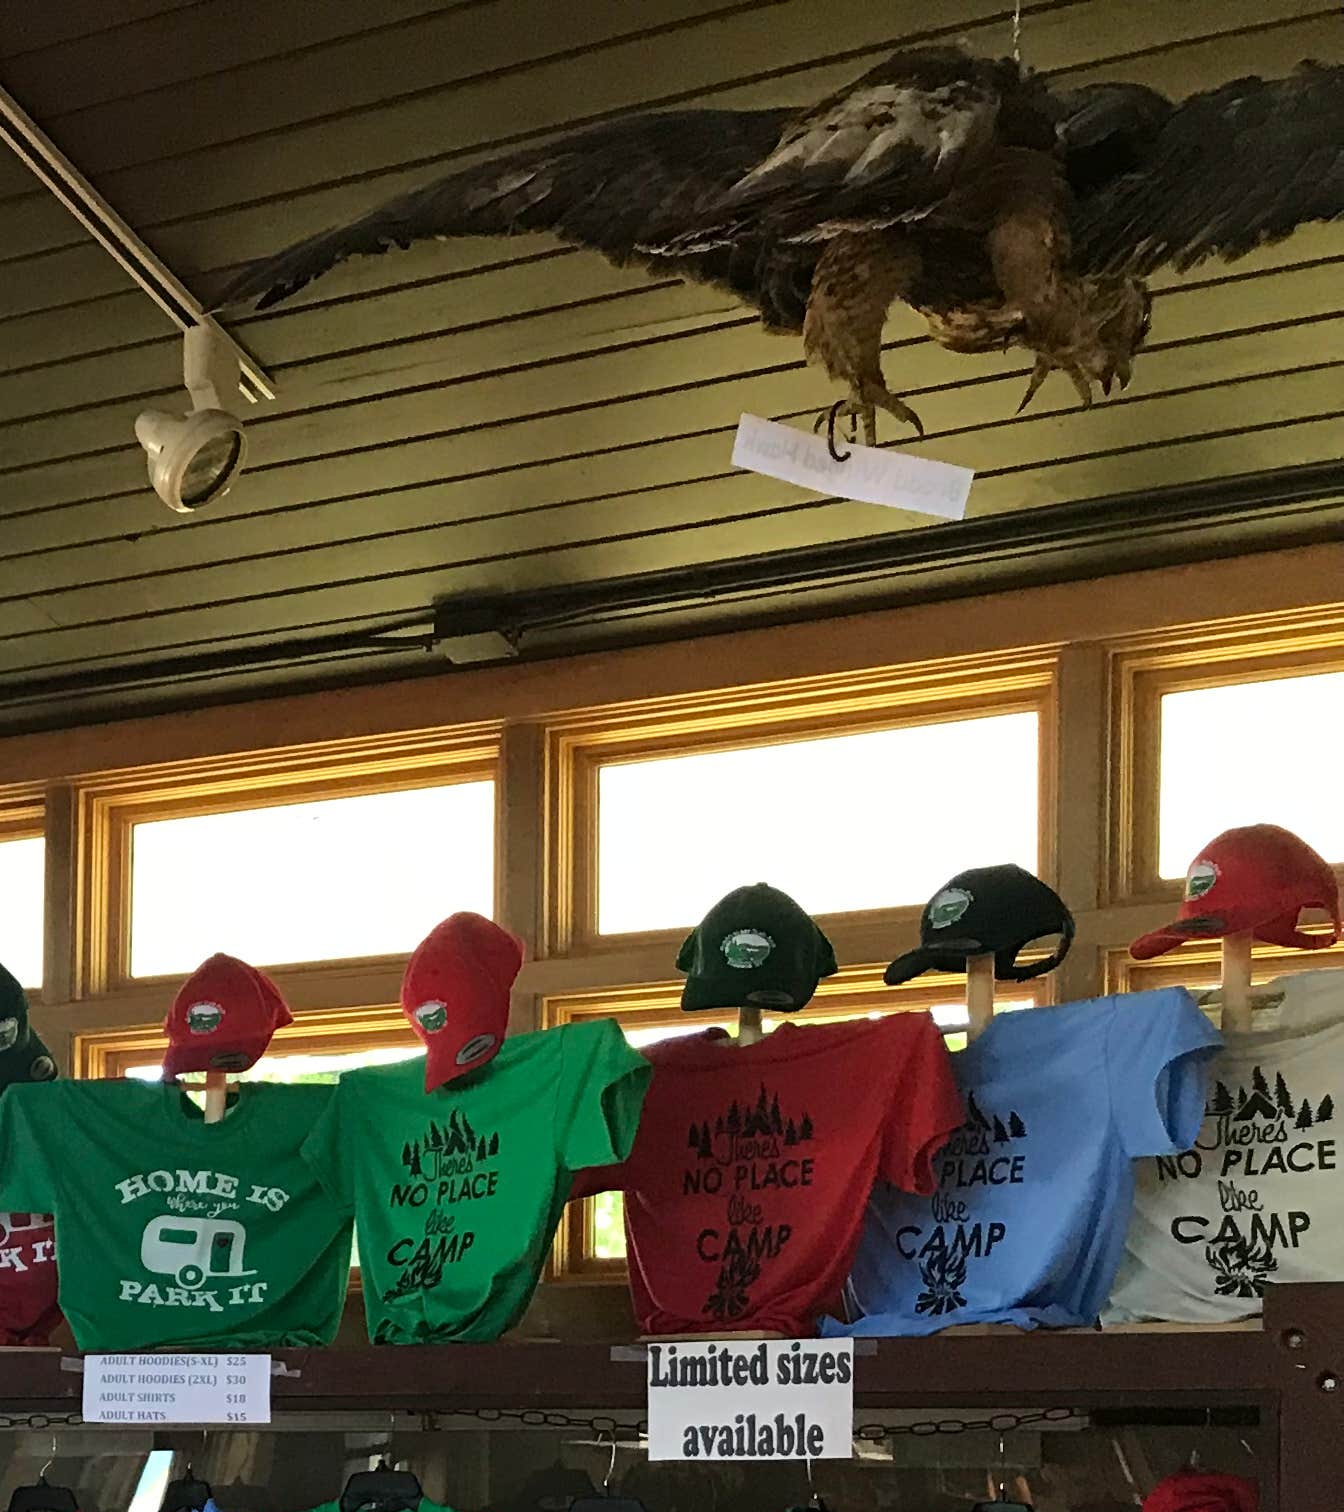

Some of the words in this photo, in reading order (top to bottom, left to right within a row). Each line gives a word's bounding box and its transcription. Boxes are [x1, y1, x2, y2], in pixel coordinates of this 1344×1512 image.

[683, 1166, 723, 1196] NO
[735, 1158, 815, 1191] PLACE
[940, 1155, 1026, 1188] PLACE
[1156, 1150, 1202, 1181] NO
[1220, 1139, 1336, 1177] PLACE
[115, 1170, 239, 1204] HOME
[246, 1185, 290, 1212] IS
[167, 1192, 207, 1213] where
[207, 1202, 240, 1218] you
[390, 1183, 429, 1208] NO
[437, 1171, 499, 1206] PLACE
[1217, 1179, 1265, 1213] like
[425, 1207, 456, 1236] like
[727, 1194, 764, 1226] like
[931, 1191, 971, 1224] like
[696, 1224, 792, 1263] CAMP
[895, 1222, 1006, 1261] CAMP
[1170, 1211, 1311, 1249] CAMP
[387, 1231, 475, 1266] CAMP
[119, 1280, 224, 1312] PARK
[229, 1283, 268, 1304] IT
[100, 1356, 136, 1367] ADULT
[226, 1356, 247, 1367] $25
[649, 1342, 770, 1388] Limited
[776, 1341, 852, 1386] sizes
[100, 1374, 136, 1385] ADULT
[138, 1374, 186, 1385] HOODIES
[187, 1375, 218, 1386] (2XL)
[226, 1375, 246, 1386] $30
[99, 1392, 136, 1403] ADULT
[137, 1393, 176, 1403] SHIRTS
[99, 1410, 135, 1421] ADULT
[137, 1411, 166, 1421] HATS
[227, 1412, 247, 1422] $15
[683, 1413, 825, 1457] available
